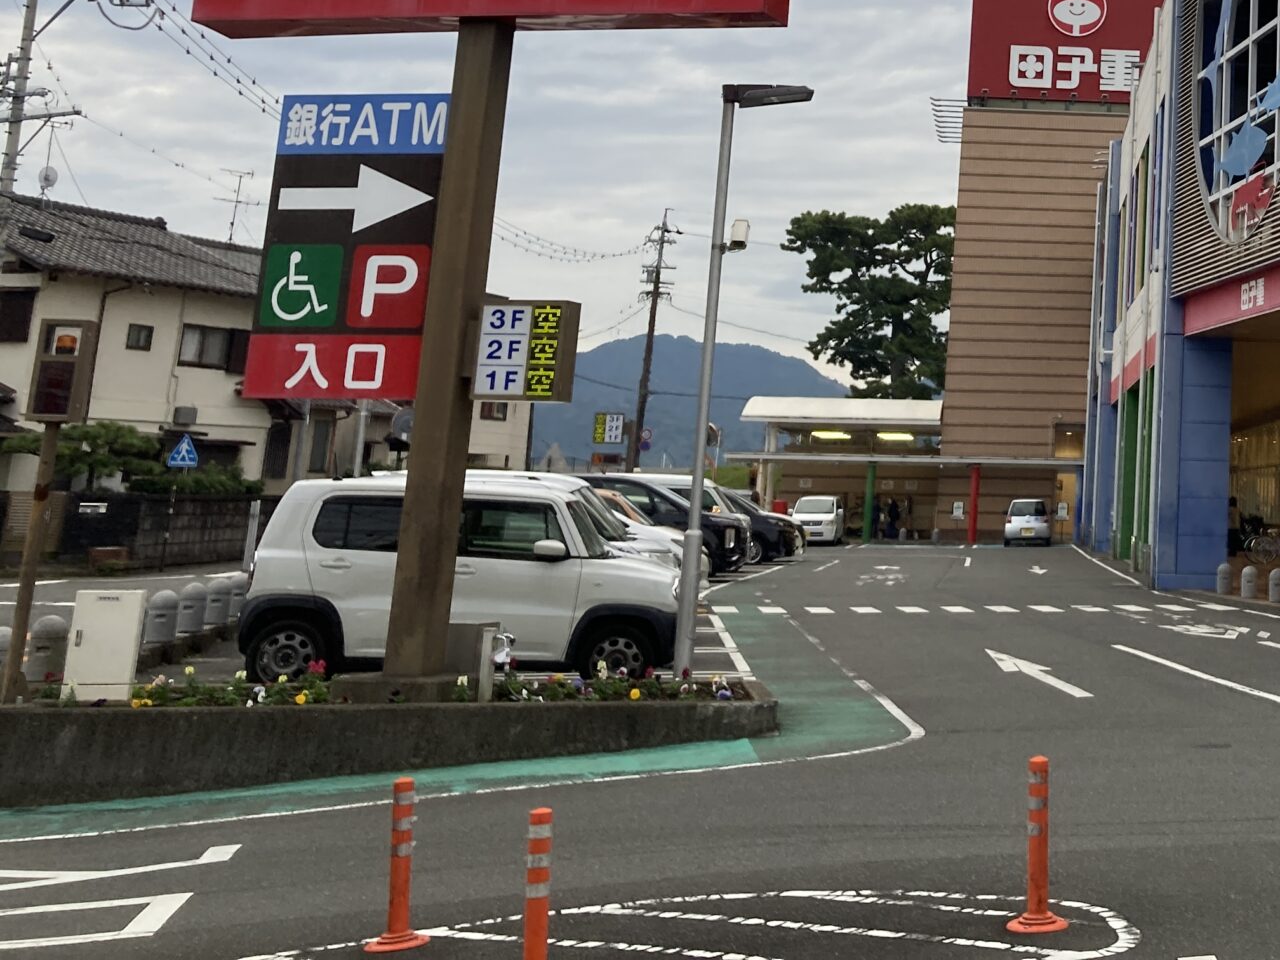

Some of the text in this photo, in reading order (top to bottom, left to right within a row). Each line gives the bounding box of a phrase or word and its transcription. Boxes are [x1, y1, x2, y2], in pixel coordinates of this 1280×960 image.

[360, 255, 419, 318] P
[489, 305, 561, 334] 3F 空
[486, 337, 558, 365] 2F 空
[284, 342, 387, 391] 入口
[485, 367, 555, 397] 1F 空
